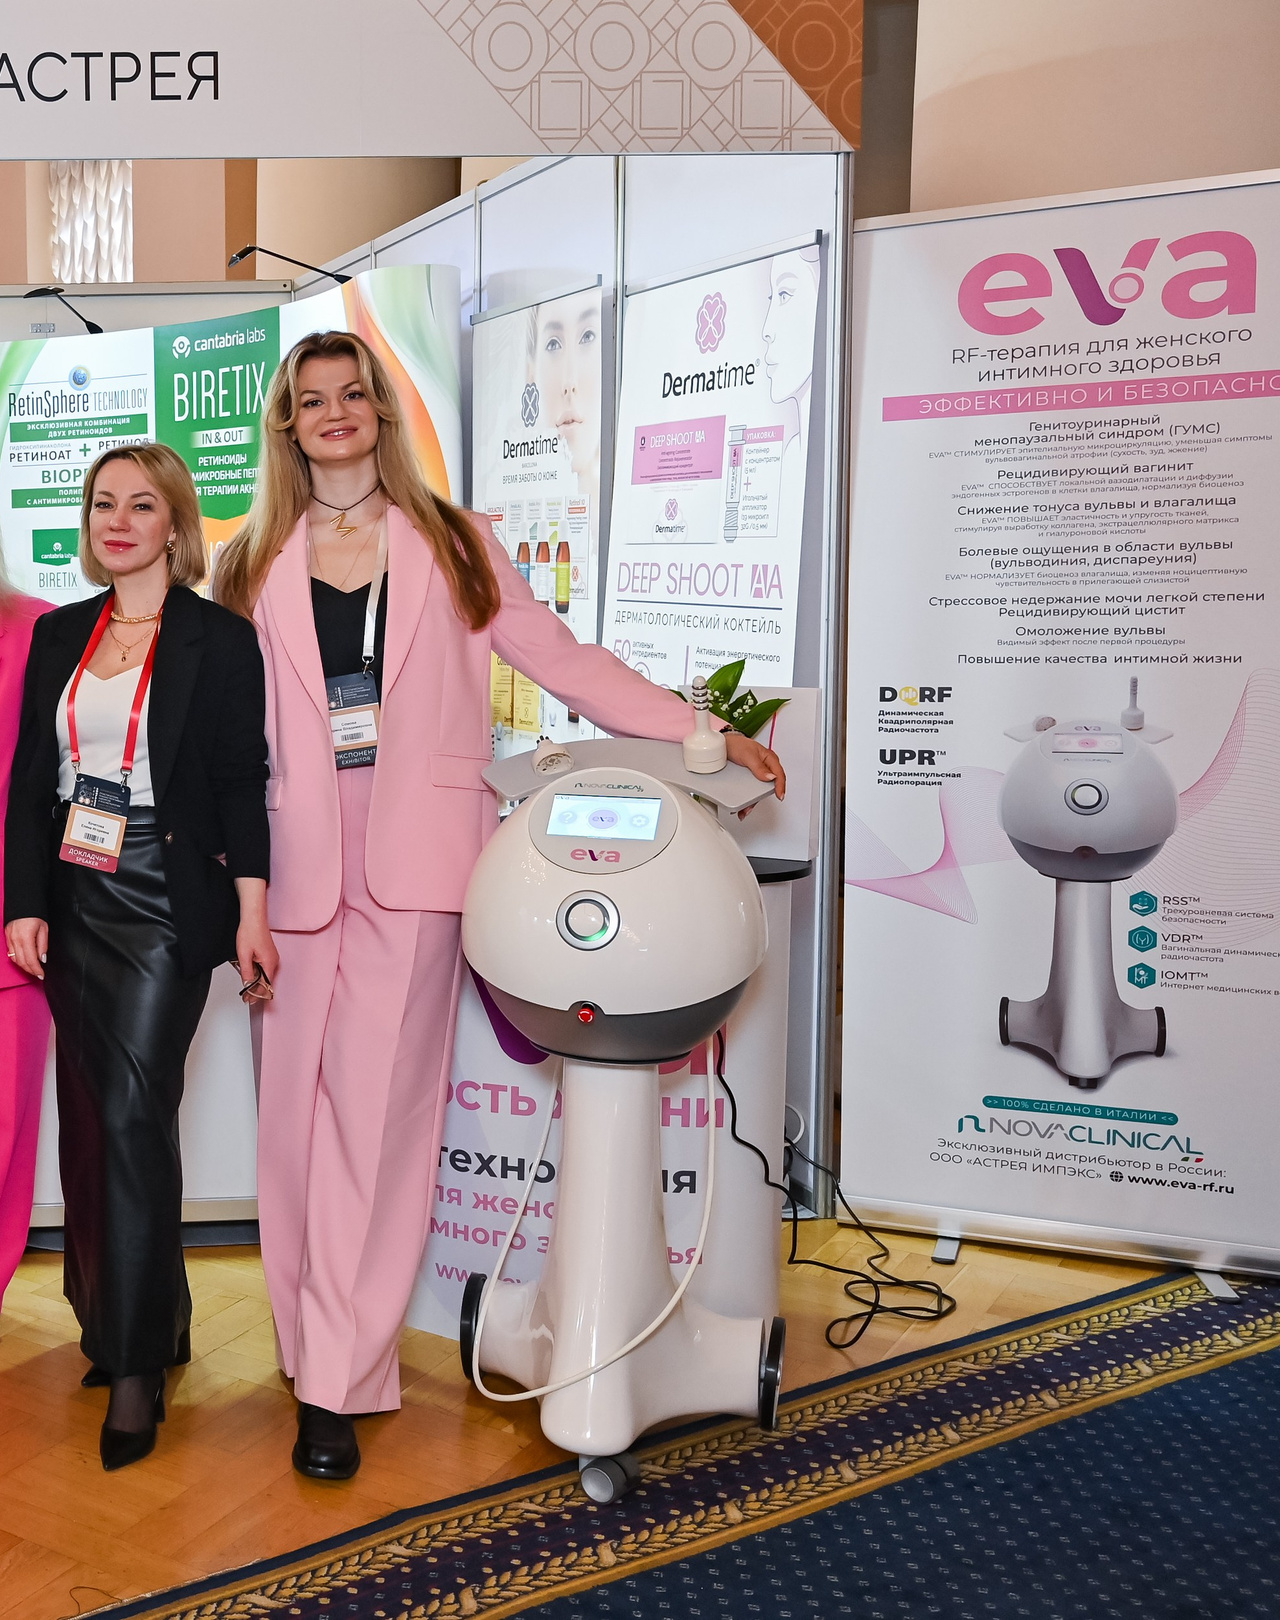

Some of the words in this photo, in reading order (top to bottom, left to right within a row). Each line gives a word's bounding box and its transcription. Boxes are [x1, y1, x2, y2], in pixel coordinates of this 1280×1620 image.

[958, 230, 1257, 336] eva
[194, 330, 244, 352] cantabria
[246, 327, 266, 343] labs
[952, 341, 1079, 364] RF-терапия
[1087, 338, 1128, 357] для
[1135, 327, 1252, 350] женского
[978, 361, 1101, 383] интимного
[1109, 351, 1221, 373] здоровья
[174, 362, 266, 422] BIRETIX
[919, 388, 1087, 414] ЭФФЕКТИВНО
[1099, 386, 1111, 401] И
[9, 390, 89, 418] RetinSphere
[93, 388, 147, 412] TECHNOLOGY
[27, 420, 82, 430] ЭКСКЛЮЗИВНАЯ
[84, 417, 130, 427] КОМБИНАЦИЯ
[1029, 415, 1160, 431] Генитоуринарный
[48, 430, 66, 438] ДВУХ
[68, 427, 112, 437] РЕТИНОИДОВ
[202, 433, 213, 444] IN
[224, 430, 243, 442] OUT
[650, 435, 665, 448] DEEP
[667, 432, 693, 446] SHOOT
[974, 431, 1094, 446] менопаузальный
[1099, 428, 1164, 440] синдром
[1170, 422, 1220, 436] (ГУМС)
[954, 447, 1016, 457] СТИМУЛИРУЕТ
[1018, 445, 1085, 454] эпителиальную
[1176, 437, 1222, 446] уменьшая
[1224, 434, 1272, 443] симптомы
[9, 450, 71, 462] РЕТИНОАТ
[199, 453, 247, 466] РЕТИНОИДЫ
[192, 469, 242, 481] МИКРОБНЫЕ
[997, 464, 1128, 480] Рецидивирующий
[1134, 462, 1194, 473] вагинит
[203, 485, 238, 496] ТЕРАПИИ
[957, 504, 1029, 515] Снижение
[1033, 503, 1079, 514] тонуса
[1085, 501, 1135, 512] вульвы
[1154, 496, 1236, 508] влагалища
[959, 547, 1018, 557] Болевые
[1022, 545, 1099, 556] ощущения
[1103, 544, 1110, 552] в
[1116, 542, 1174, 552] области
[1180, 541, 1233, 552] вульвы
[990, 557, 1090, 569] (вульводиния,
[1093, 553, 1197, 566] диспареуния)
[39, 572, 77, 588] BIRETIX
[617, 562, 661, 593] DEEP
[667, 562, 743, 597] SHOOT
[929, 597, 1007, 608] Стрессовое
[1012, 595, 1100, 606] недержание
[1105, 595, 1142, 603] мочи
[1146, 592, 1198, 603] легкой
[1203, 593, 1265, 601] степени
[999, 606, 1130, 618] Рецидивирующий
[1135, 607, 1185, 616] цистит
[615, 610, 719, 629] ДЕРМАТОЛОГИЧЕСКИЙ
[724, 617, 781, 635] КОКТЕЙЛЬ
[1016, 626, 1109, 636] Омоложение
[1114, 627, 1165, 637] вульвы
[632, 650, 667, 660] ингредиентов
[696, 646, 725, 657] Активация
[727, 651, 780, 662] энергетического
[958, 654, 1040, 664] Повышение
[1045, 655, 1107, 664] качества
[1114, 654, 1188, 664] интимной
[1193, 655, 1242, 664] жизни
[342, 757, 370, 765] EXHIBITOR
[878, 770, 961, 778] Ультраимпульсная
[68, 848, 108, 863] ДОКЛАДЧИК
[76, 857, 99, 866] SPEAKER
[571, 848, 621, 863] eva
[1162, 907, 1232, 917] Трехуровневая
[1162, 916, 1227, 925] безопасности
[1161, 954, 1224, 962] радиочастота
[1160, 982, 1204, 991] Интернет
[1207, 985, 1271, 995] медицинских
[1002, 1098, 1029, 1110] 100%
[1033, 1101, 1090, 1115] СДЕЛАНО
[1095, 1107, 1102, 1115] В
[1107, 1108, 1157, 1121] ИТАЛИИ
[989, 1116, 1203, 1155] NOVACLINICAL
[937, 1138, 1042, 1158] Эксклюзивный
[1045, 1151, 1151, 1172] дистрибьютор
[1156, 1163, 1163, 1171] в
[1168, 1162, 1226, 1178] России:
[930, 1152, 962, 1164] ООО
[967, 1156, 1028, 1172] «АСТРЕЯ
[1032, 1164, 1101, 1180] ИМПЭКС»
[1128, 1174, 1235, 1194] www.eva-rf.ru
